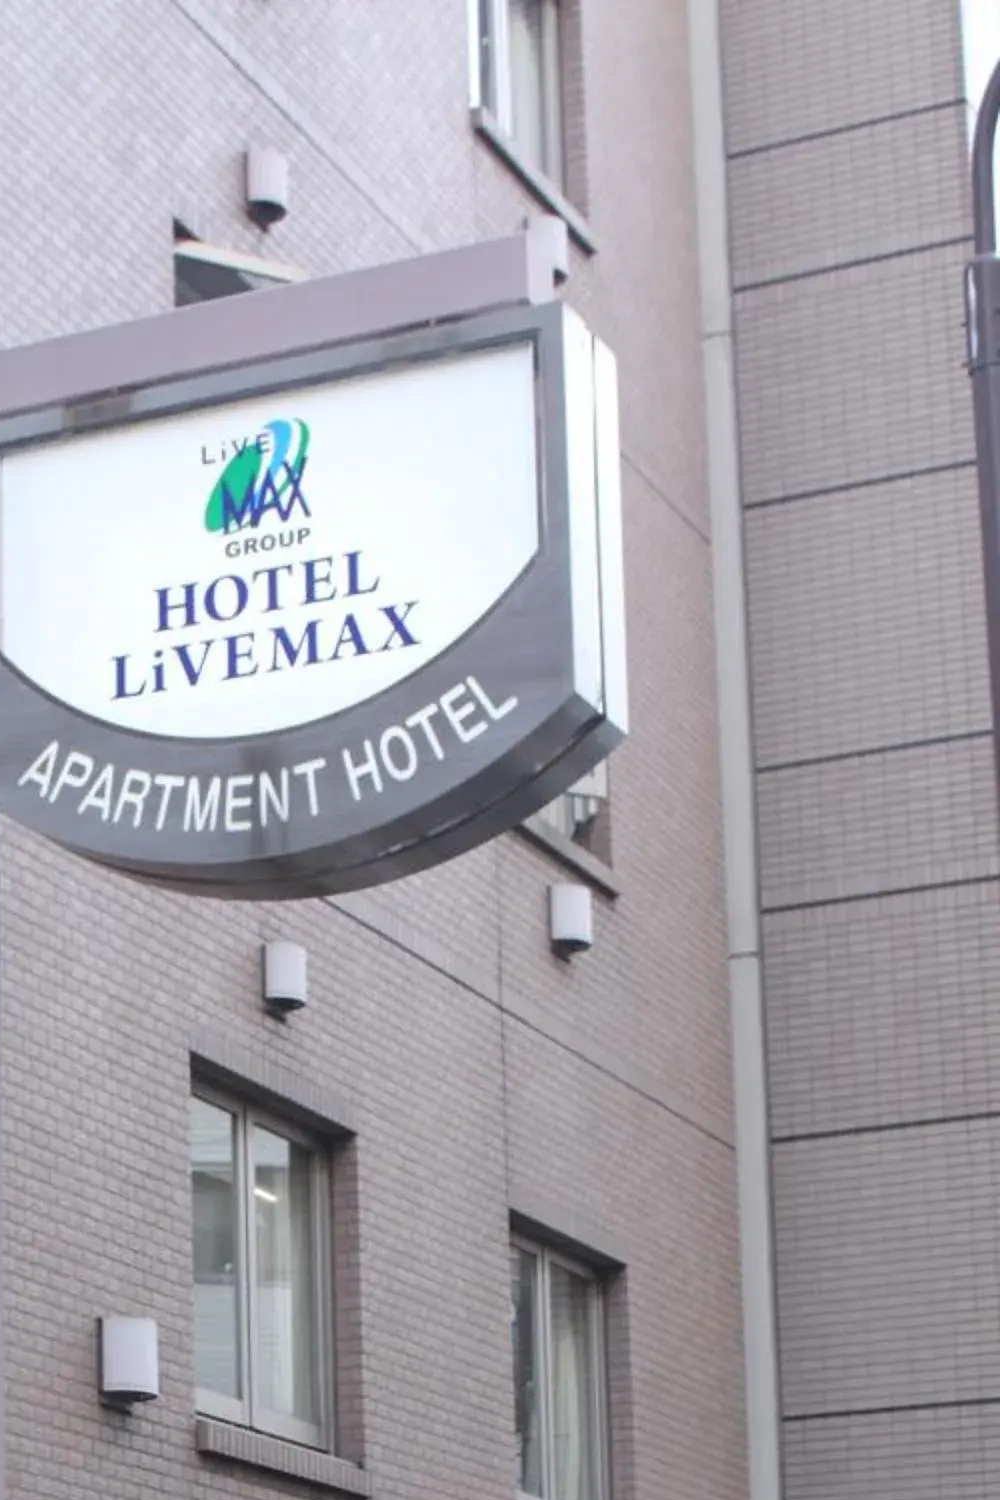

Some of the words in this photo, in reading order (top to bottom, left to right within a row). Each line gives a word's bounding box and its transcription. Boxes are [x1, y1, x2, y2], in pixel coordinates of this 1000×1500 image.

[219, 457, 312, 535] MAX
[224, 527, 312, 559] GROUP
[153, 550, 381, 633] HOTEL
[110, 600, 421, 700] LiVEMAX
[17, 738, 328, 834] APARTMENT
[341, 673, 519, 802] HOTEL
